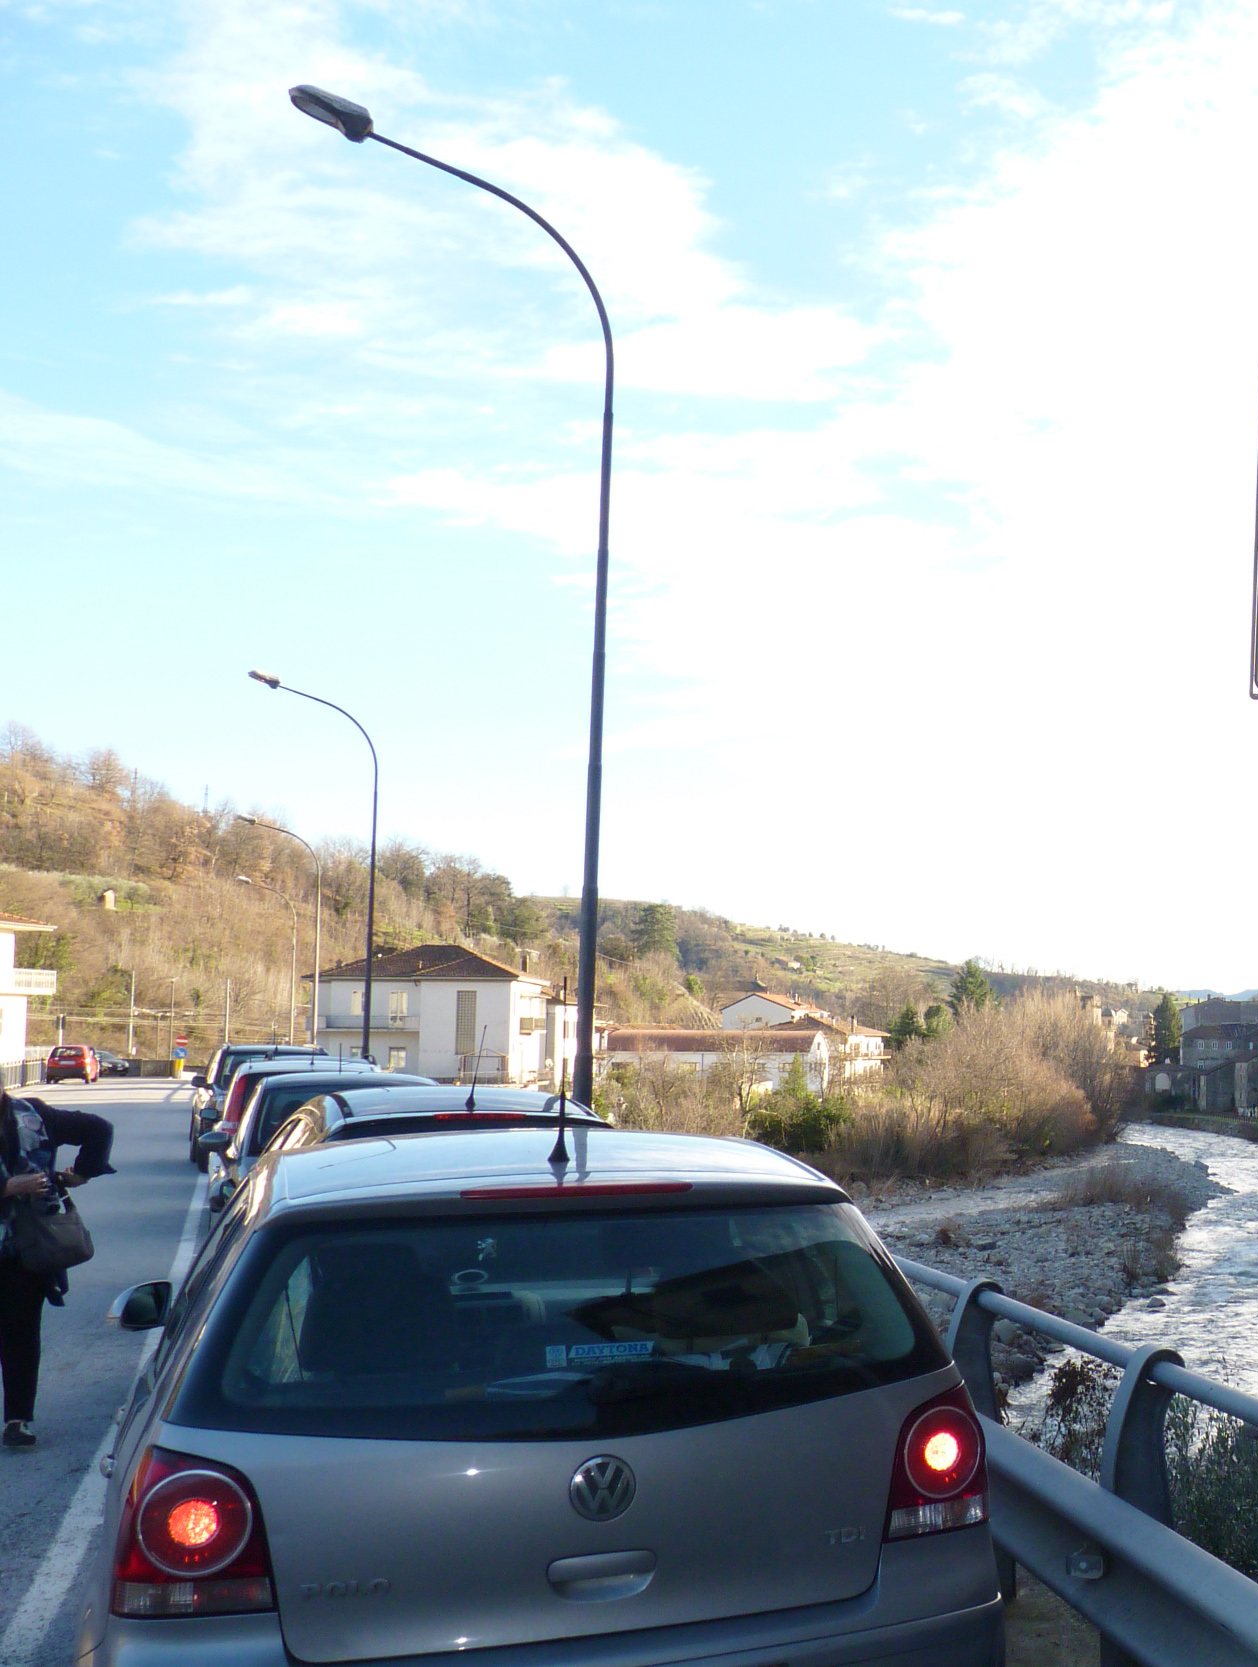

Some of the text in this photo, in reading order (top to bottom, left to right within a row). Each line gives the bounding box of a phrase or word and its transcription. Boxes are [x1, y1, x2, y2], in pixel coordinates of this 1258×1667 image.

[574, 1343, 650, 1356] DAYTONA
[824, 1525, 866, 1545] TDI
[300, 1578, 392, 1601] POLO
